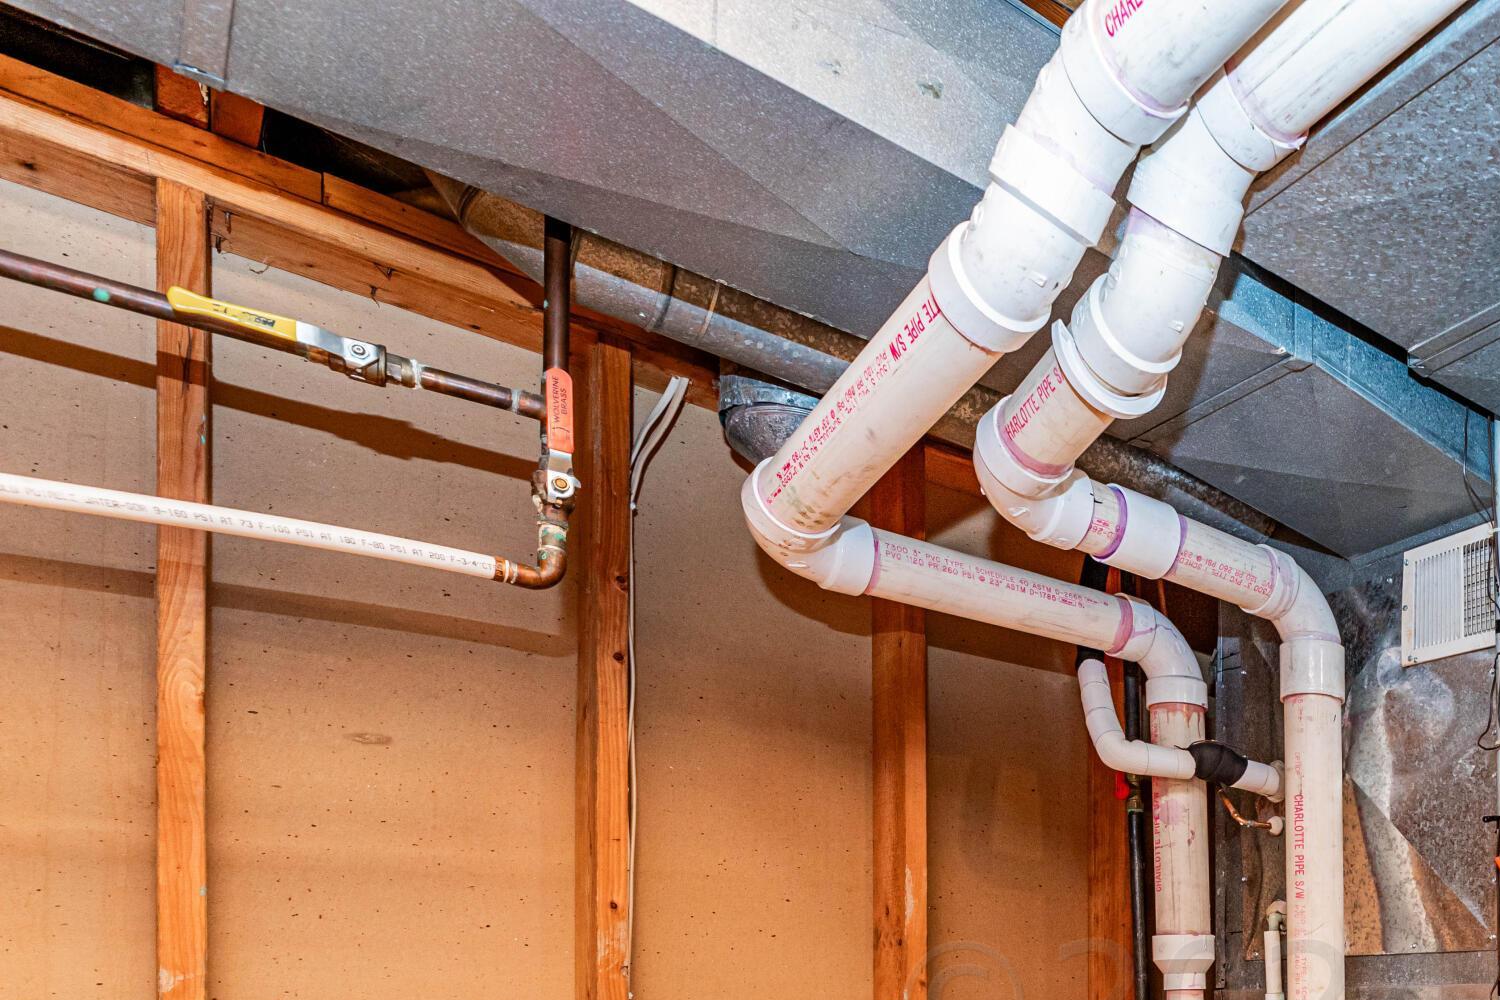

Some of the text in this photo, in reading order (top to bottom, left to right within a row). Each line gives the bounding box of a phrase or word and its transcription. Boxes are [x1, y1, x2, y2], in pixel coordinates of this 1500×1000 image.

[902, 311, 925, 343] PIPE
[552, 376, 560, 423] WOLVERINE
[560, 388, 568, 415] BRASS
[1004, 393, 1041, 439] HARLOTTE
[1034, 374, 1056, 403] PIPE
[1294, 794, 1304, 898] CHARLOTTE PIPE S/W
